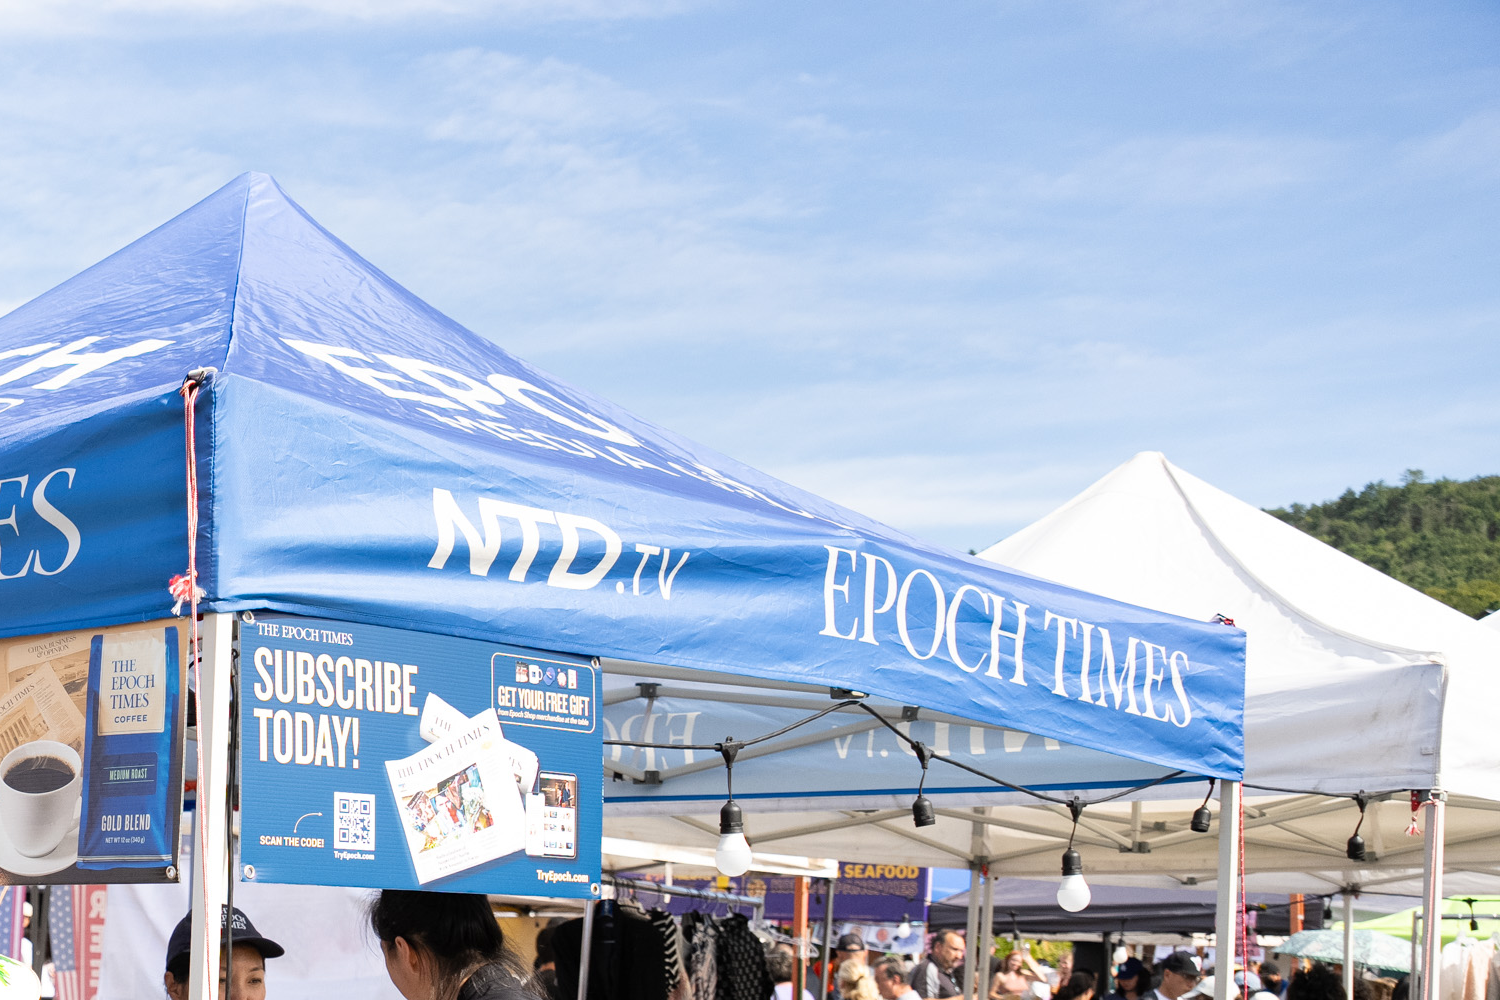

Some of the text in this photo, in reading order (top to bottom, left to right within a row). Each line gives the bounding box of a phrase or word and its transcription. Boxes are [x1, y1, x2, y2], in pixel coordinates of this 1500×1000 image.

[427, 487, 691, 601] NTD.TV
[257, 622, 354, 646] THE EPOCH TIMES
[819, 544, 1193, 728] EPOCH TIMES
[112, 659, 137, 673] THE
[111, 674, 155, 690] EPOCH
[253, 646, 419, 717] SUBSCRIBE
[13, 683, 35, 702] TIMES
[110, 693, 149, 709] TIMES
[498, 685, 590, 717] GET YOUR FREE GIFT
[114, 715, 148, 723] COFFEE
[509, 710, 523, 718] Epoch
[524, 711, 536, 720] Shop
[253, 707, 360, 769] TODAY!
[109, 768, 148, 780] MEDIUM ROAST
[101, 814, 151, 831] GOLD BLEND
[260, 835, 325, 848] SCAN THE CODE!
[334, 851, 375, 860] TryEpoch.com
[536, 869, 589, 884] TryEpoch.com
[844, 864, 920, 880] SEAFOOD
